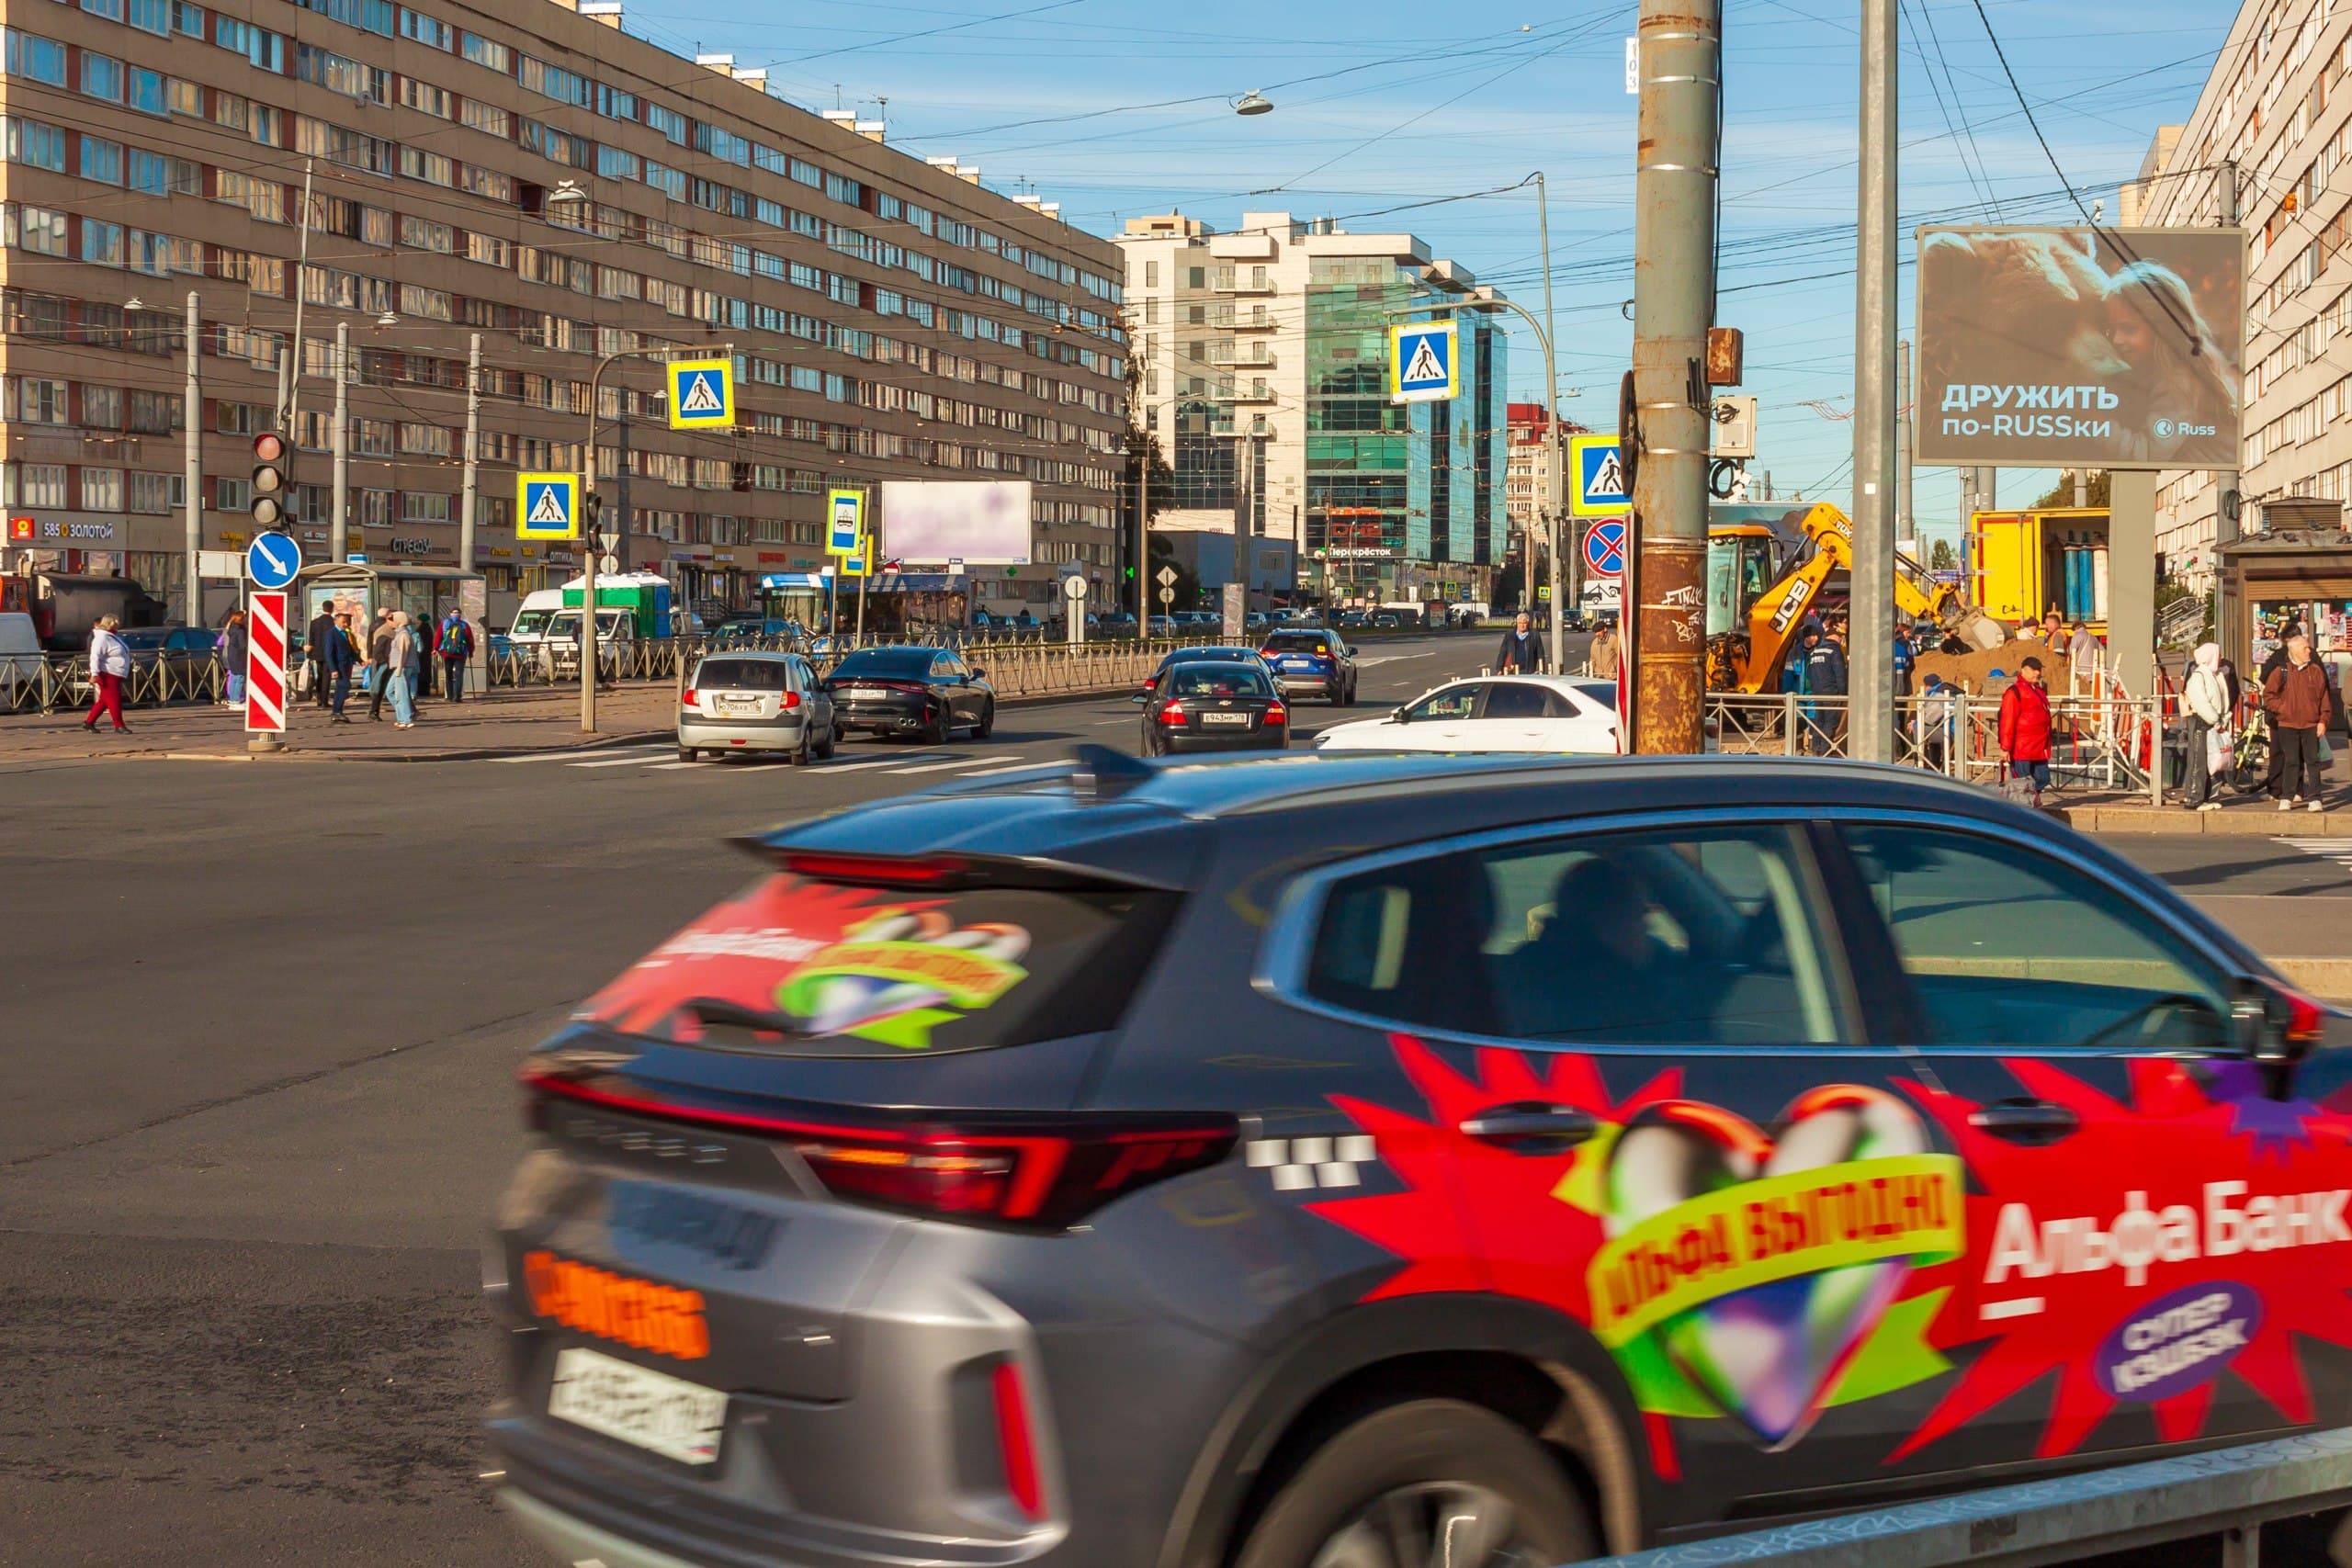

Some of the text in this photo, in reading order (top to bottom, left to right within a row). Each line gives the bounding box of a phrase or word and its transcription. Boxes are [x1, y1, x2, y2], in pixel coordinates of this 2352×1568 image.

[1941, 384, 2119, 412] ДРУЖИТЬ
[1942, 414, 2110, 437] по-RUSSки
[2178, 422, 2216, 435] Russ
[44, 523, 113, 538] 585 ЗОЛОТОЙ
[1773, 579, 1811, 633] JCB
[1983, 1190, 2201, 1287] Альфа
